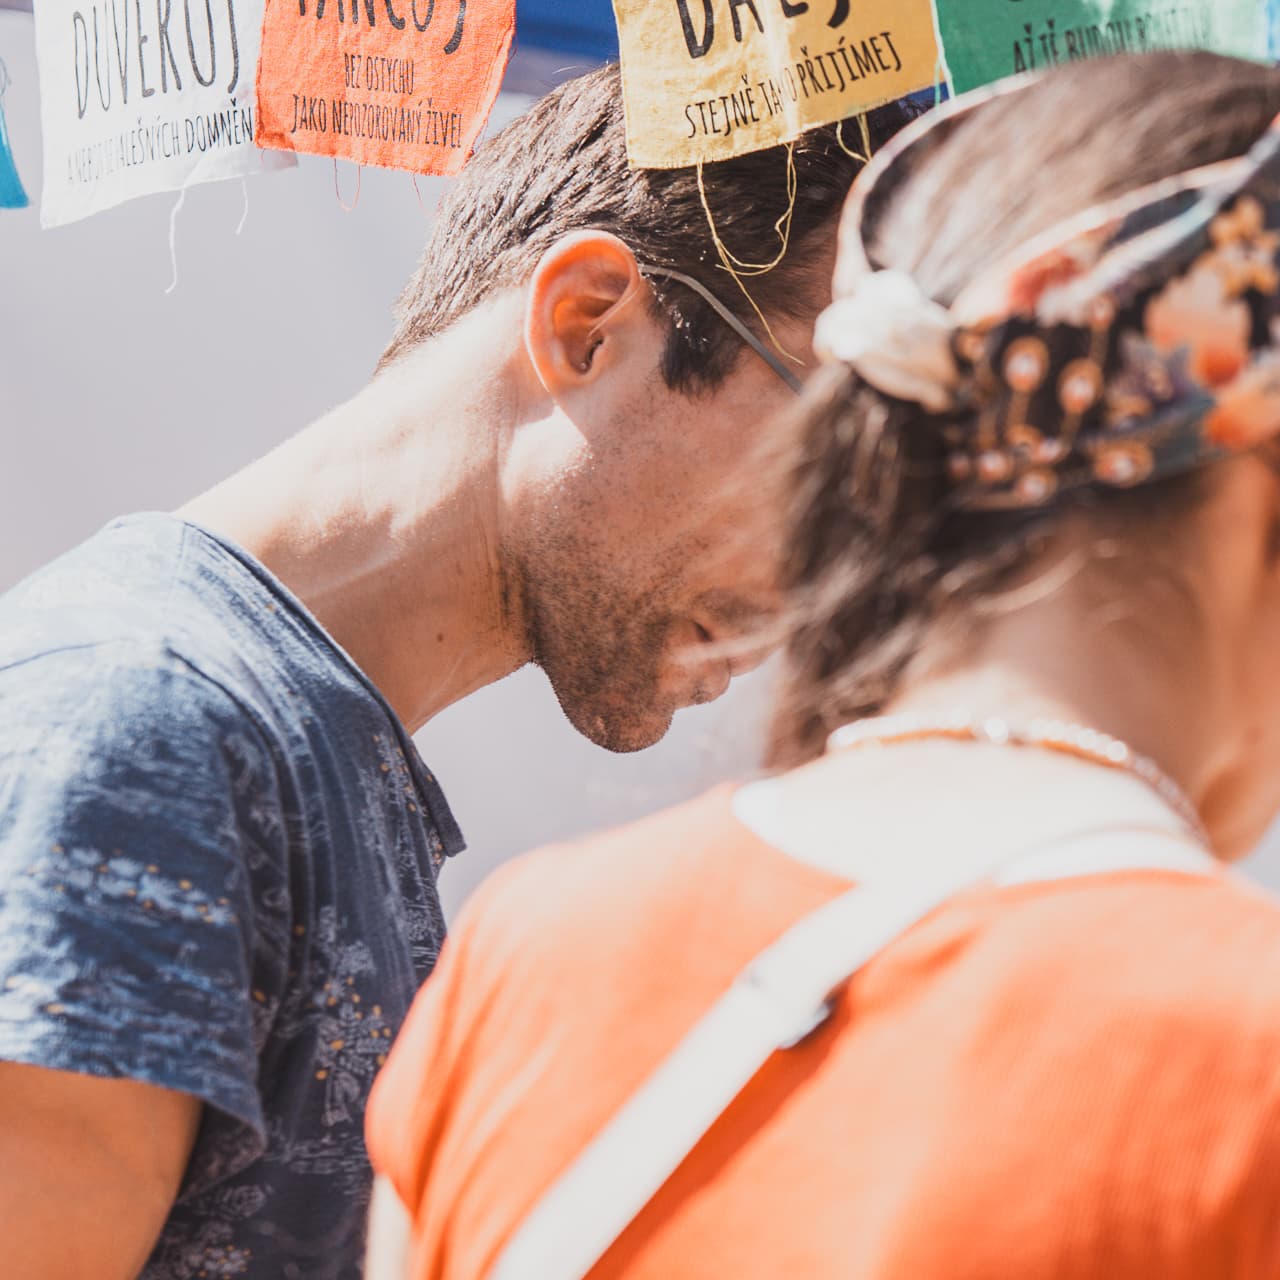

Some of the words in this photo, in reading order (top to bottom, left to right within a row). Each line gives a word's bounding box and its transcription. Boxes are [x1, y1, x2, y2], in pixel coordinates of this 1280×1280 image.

[343, 52, 362, 89] BEZ
[366, 55, 415, 96] OSTYCHU
[684, 73, 761, 139] STEJNĚ
[796, 31, 903, 99] PŘIJÍMEJ
[290, 94, 327, 134] JAKO
